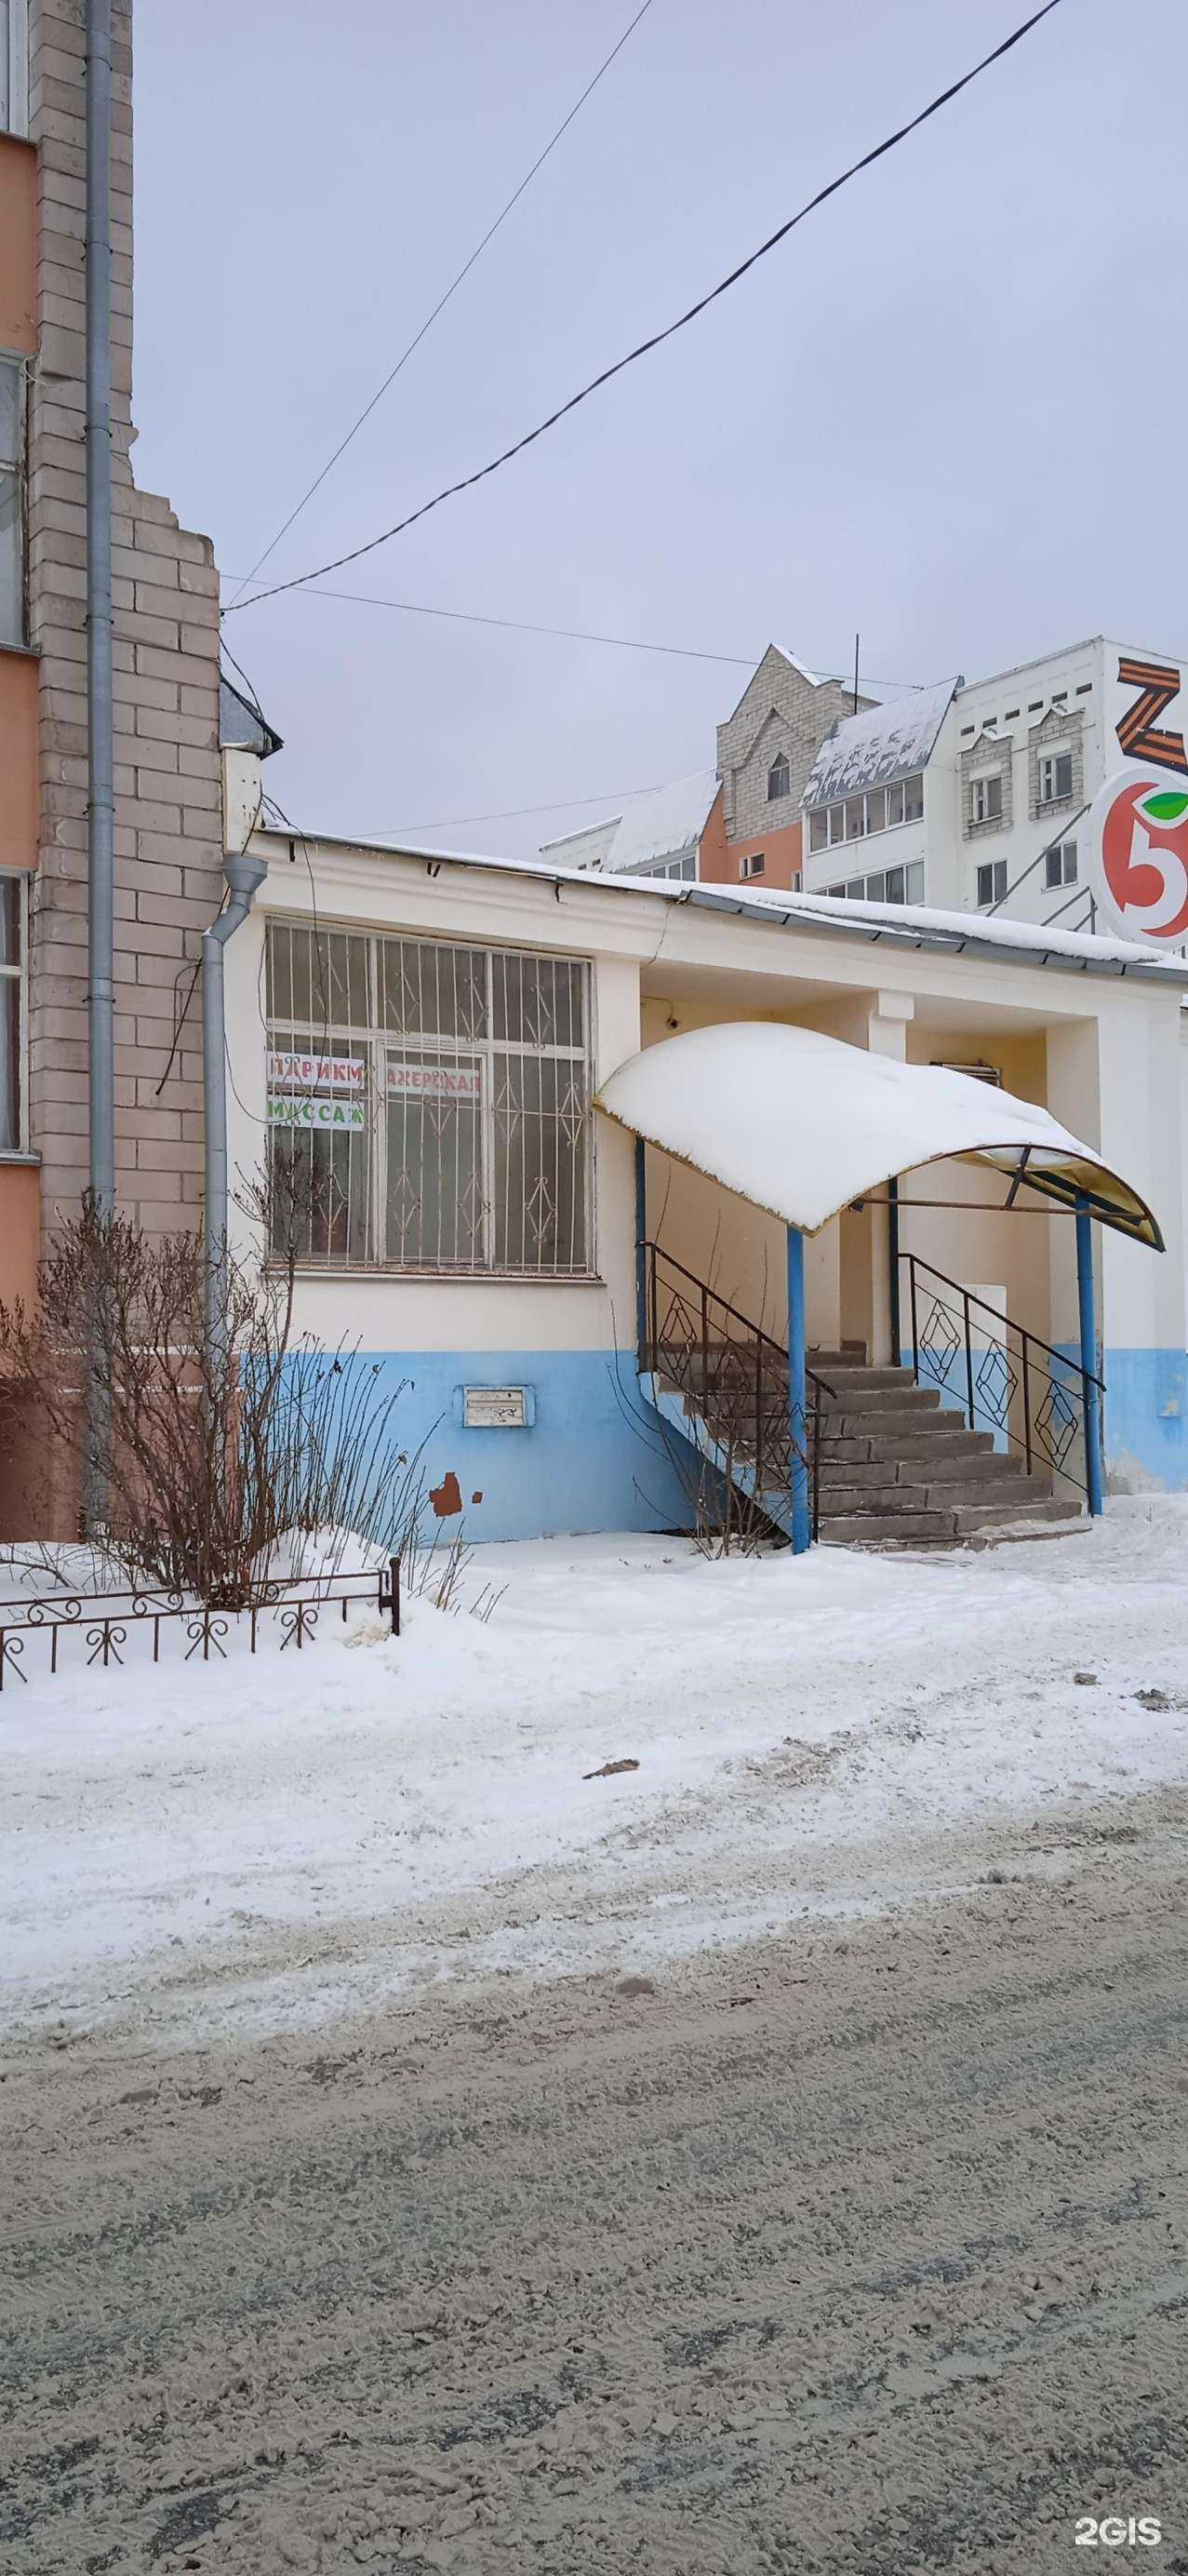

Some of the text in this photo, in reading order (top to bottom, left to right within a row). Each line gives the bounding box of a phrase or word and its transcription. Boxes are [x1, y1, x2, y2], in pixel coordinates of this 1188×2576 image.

[1115, 657, 1188, 776] Z
[1123, 818, 1187, 931] 5
[270, 1057, 364, 1082] ПАРИКМ
[268, 1101, 364, 1123] МАССАЖ
